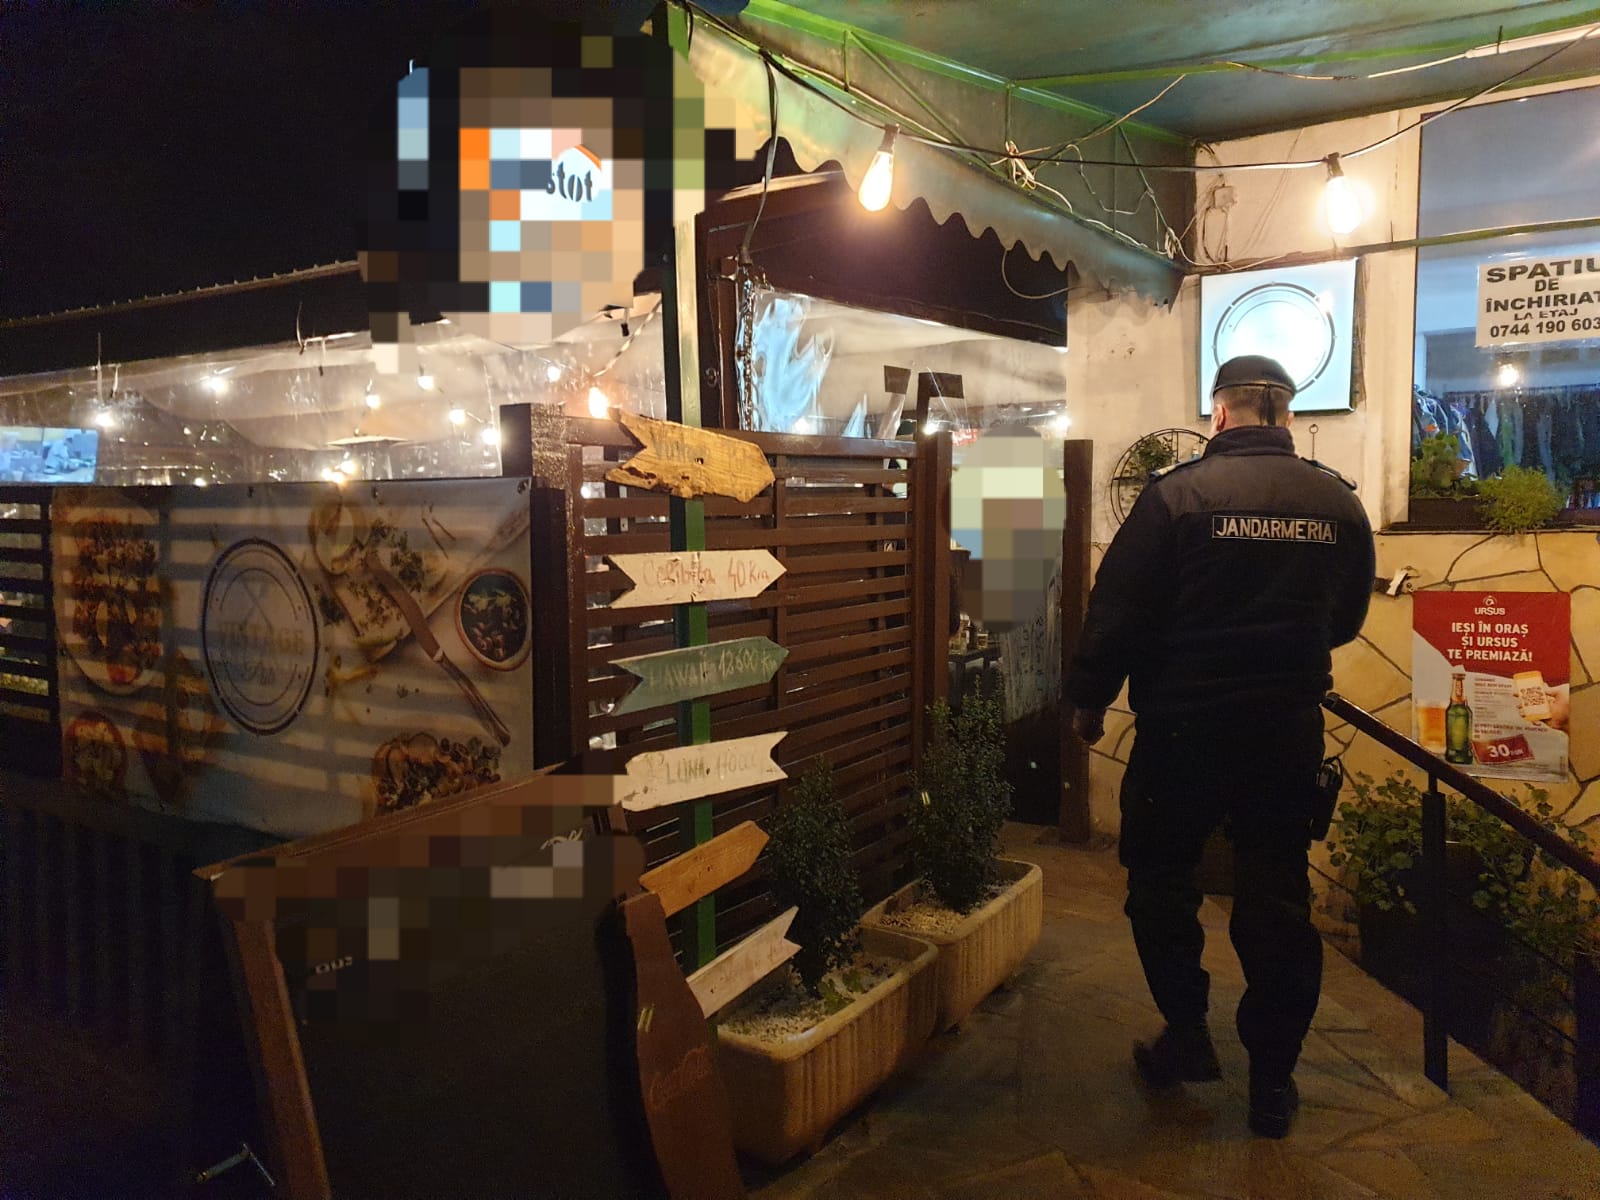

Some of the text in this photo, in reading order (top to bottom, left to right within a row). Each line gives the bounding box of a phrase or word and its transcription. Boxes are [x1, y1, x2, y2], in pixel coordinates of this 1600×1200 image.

[1487, 258, 1600, 283] SPATIU
[1535, 278, 1559, 292] DE
[1514, 308, 1578, 321] LA ETAJ
[1490, 317, 1600, 338] 0744 190 603
[1216, 518, 1333, 541] JANDARMERIA
[728, 556, 746, 592] 40
[1474, 607, 1505, 615] URSUS
[1452, 621, 1528, 637] IEȘI ÎN ORAȘ
[1461, 636, 1518, 649] ȘI URSUS
[1448, 649, 1532, 662] TE PREMIAZĂ!
[1487, 744, 1510, 758] 30
